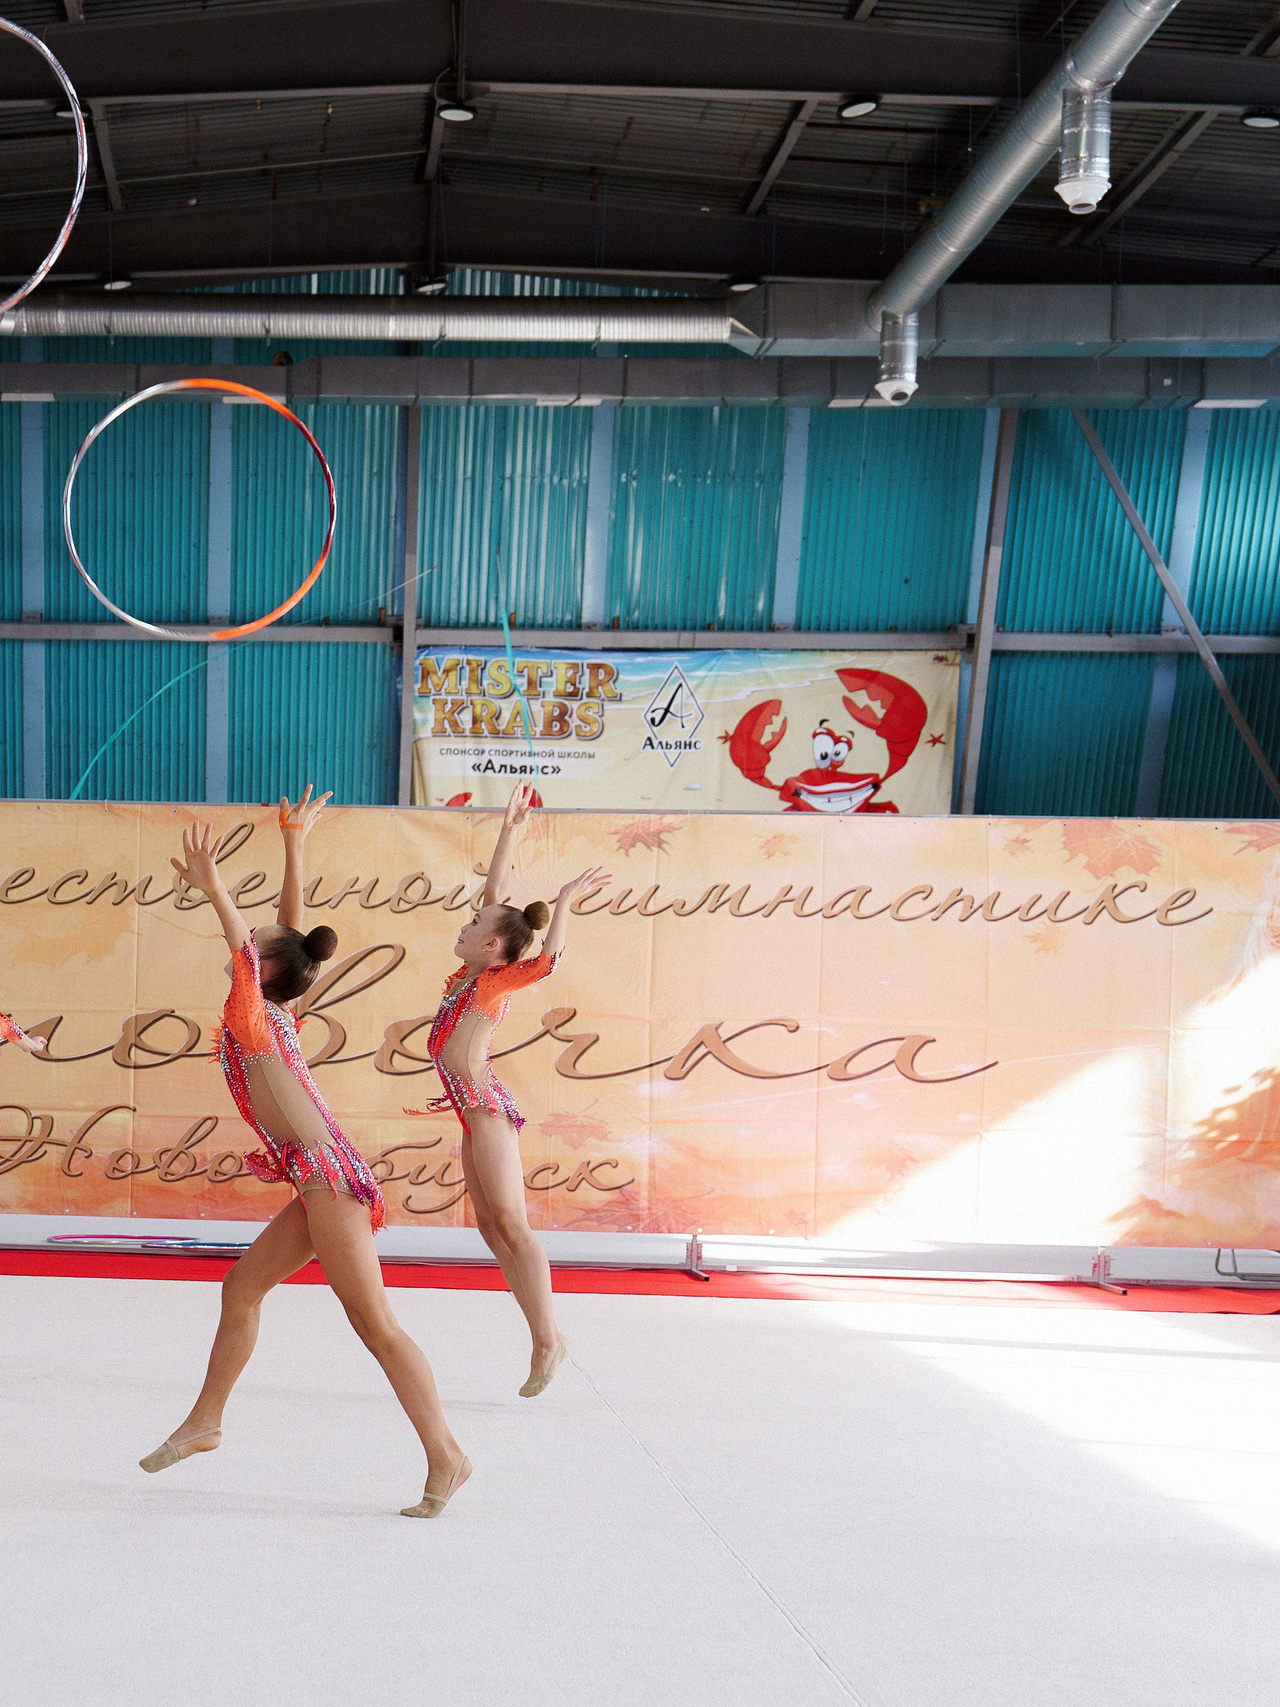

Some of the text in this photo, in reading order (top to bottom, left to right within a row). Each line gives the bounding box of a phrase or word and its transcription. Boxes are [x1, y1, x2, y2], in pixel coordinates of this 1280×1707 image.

[417, 656, 622, 701] MISTER
[430, 696, 606, 741] KRABS
[439, 747, 596, 759] СПОНСОР СПОРТИВНОЙ ШКОЛЫ
[642, 736, 702, 750] Альянс
[471, 758, 562, 775] «Альянс»
[548, 880, 1214, 927] гимнастике
